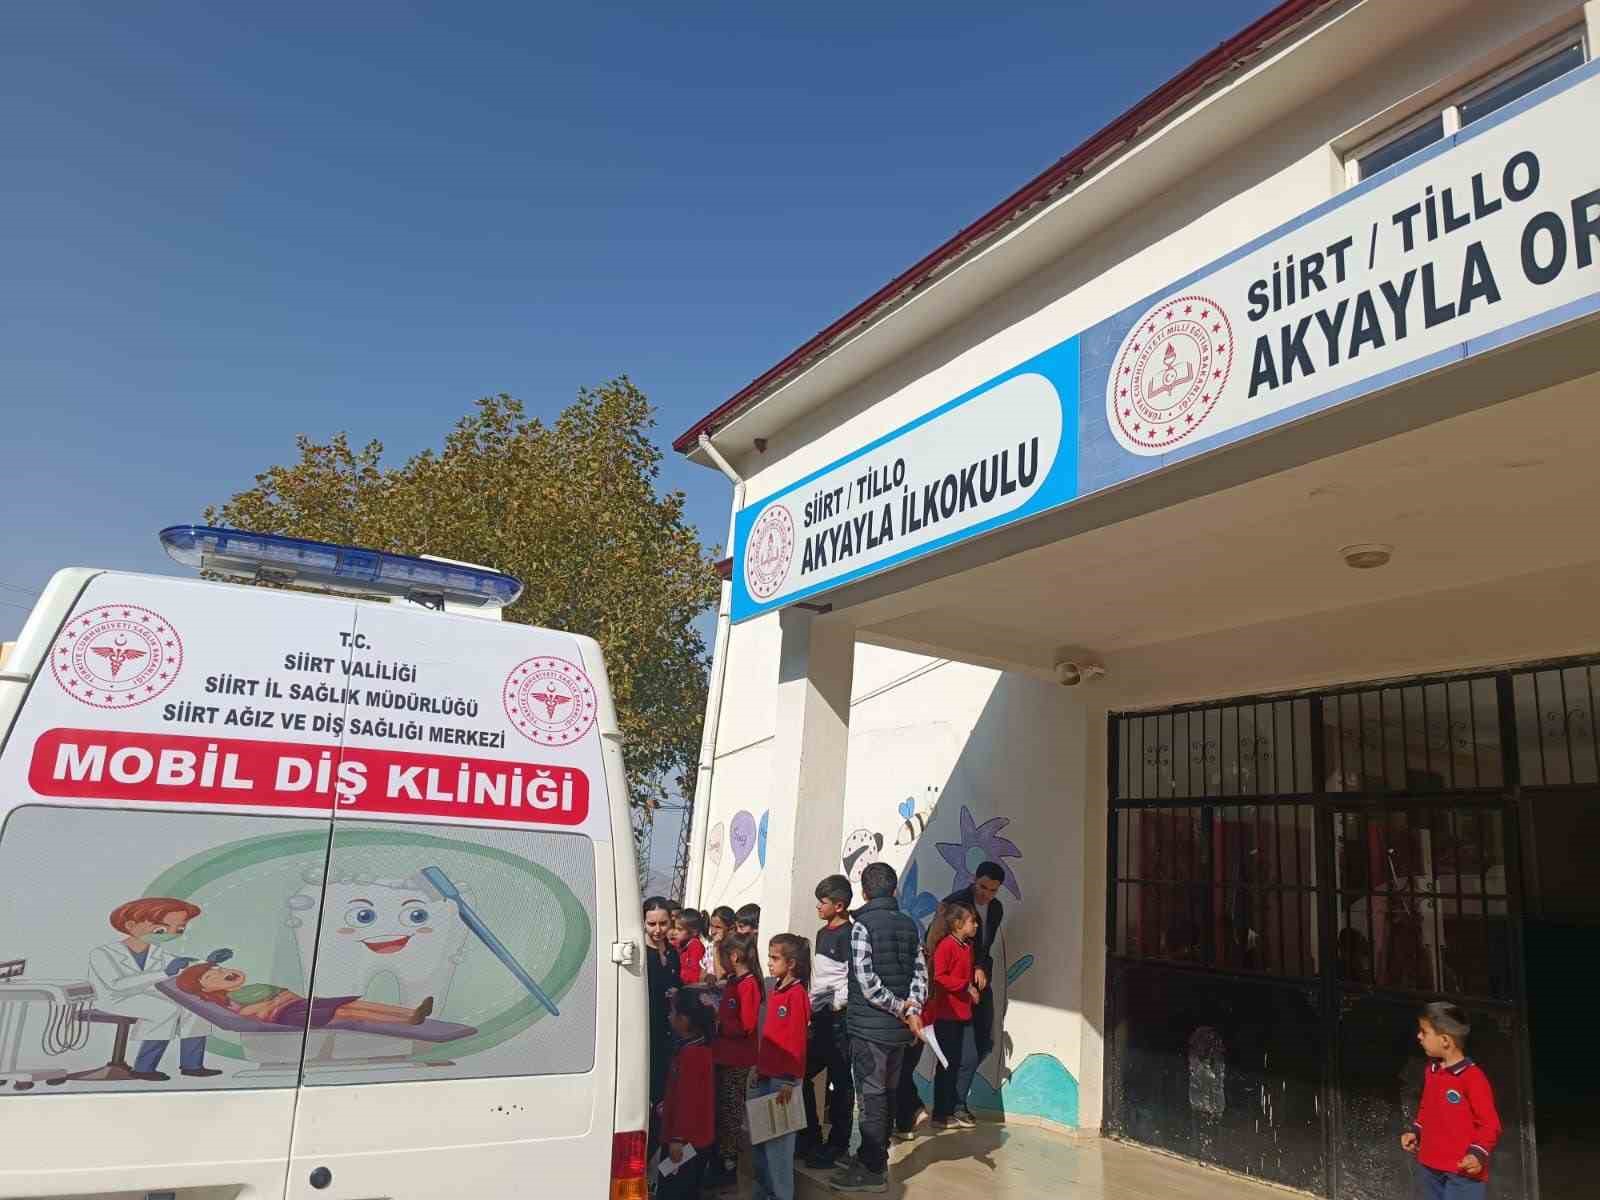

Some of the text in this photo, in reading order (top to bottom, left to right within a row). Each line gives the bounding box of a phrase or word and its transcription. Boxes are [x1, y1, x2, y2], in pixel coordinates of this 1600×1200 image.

[1246, 150, 1541, 322] SİİRT / TİLLO
[1247, 240, 1501, 399] AKYAYLA
[801, 503, 894, 575] AKYAYLA
[901, 436, 1039, 536] İLKOKULU
[803, 488, 842, 528] SİİRT
[857, 458, 905, 505] TİLLO
[284, 653, 417, 683] SİİRT VALİLİĞİ
[339, 632, 371, 649] T.C.
[163, 702, 505, 749] SİİRT AĞIZ VE DİŞ SAĞLIĞI MERKEZİ
[205, 674, 479, 718] SİİRT İL SAĞLIK MÜDÜRLÜĞÜ
[53, 743, 574, 812] MOBİL DİŞ KLİNİĞİ
